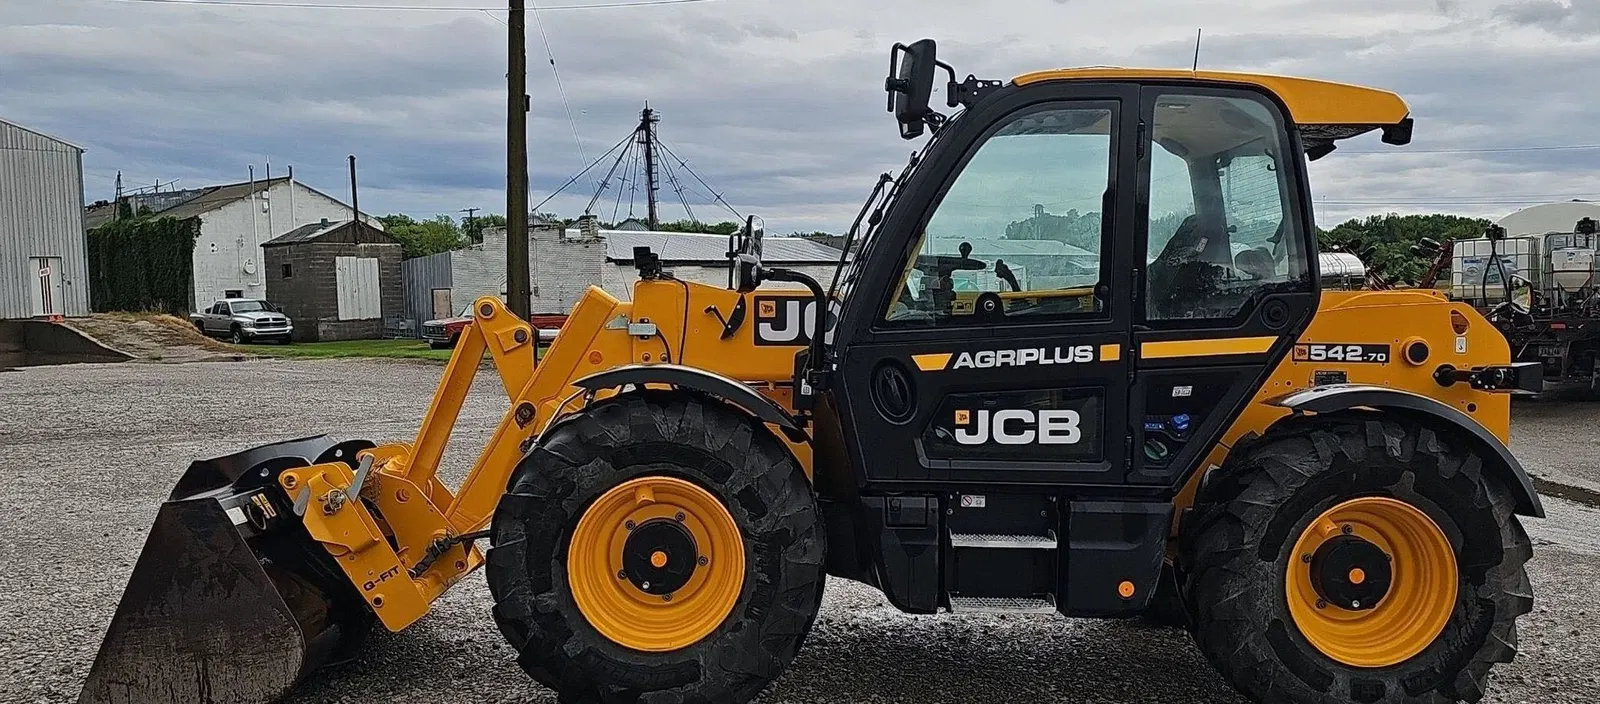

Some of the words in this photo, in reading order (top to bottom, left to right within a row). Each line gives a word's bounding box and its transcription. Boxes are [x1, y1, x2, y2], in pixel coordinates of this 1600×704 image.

[759, 300, 838, 345] JC
[953, 345, 1093, 370] AGRIPLUS
[1310, 345, 1386, 361] 542-70
[955, 409, 1081, 444] JCB
[363, 565, 399, 591] Q-FIT
